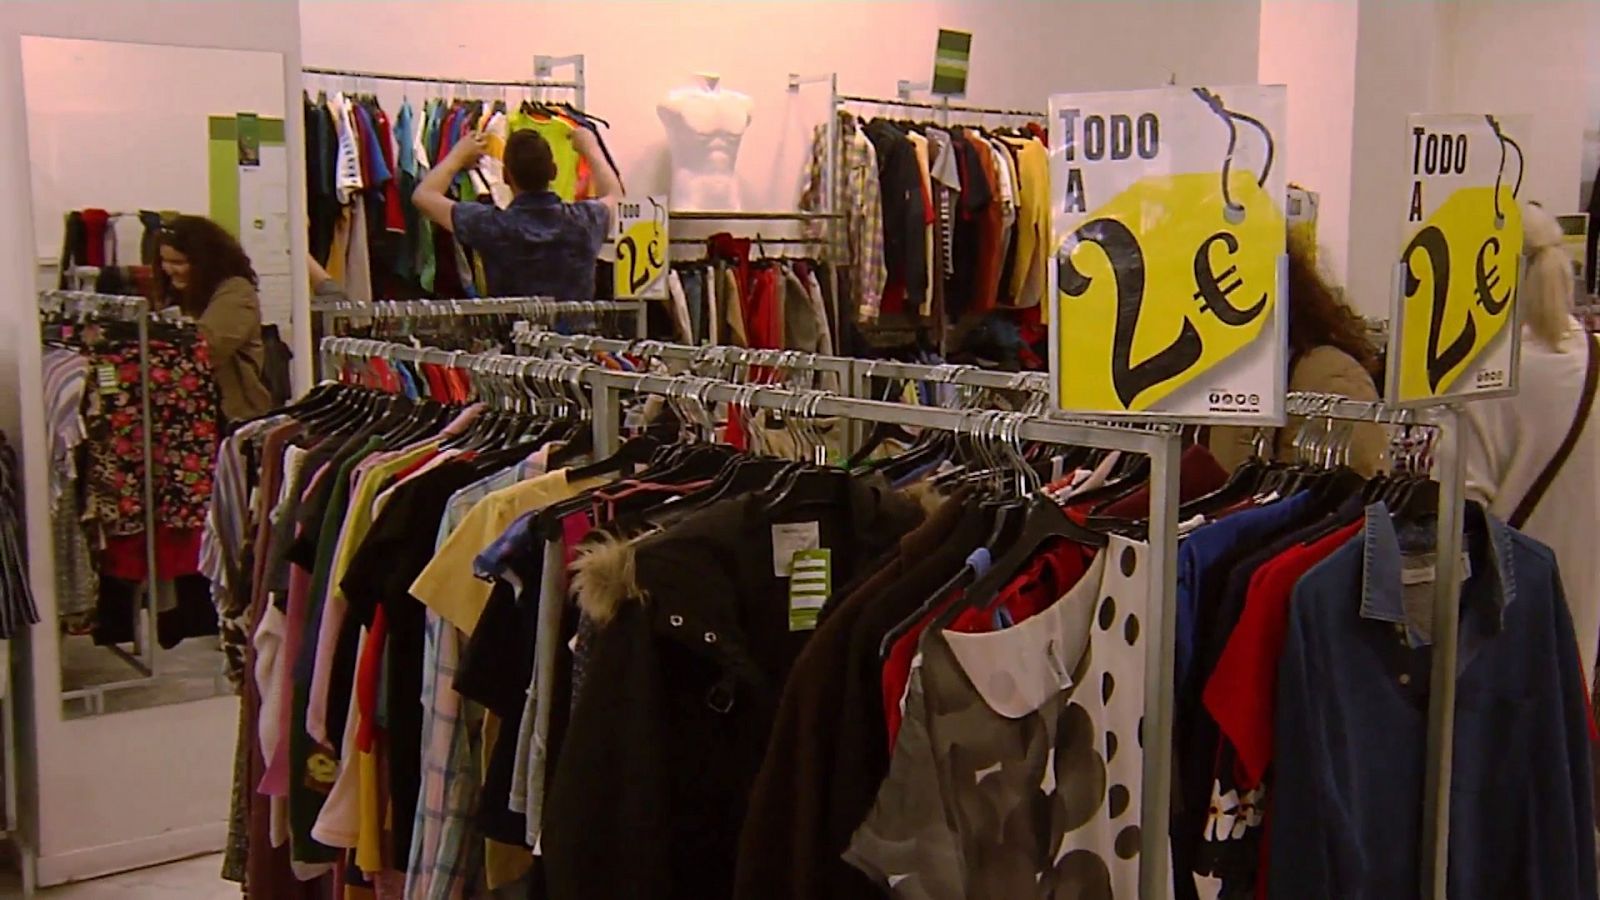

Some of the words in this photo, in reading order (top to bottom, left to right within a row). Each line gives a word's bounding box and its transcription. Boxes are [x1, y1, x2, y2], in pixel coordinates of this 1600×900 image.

[1059, 109, 1160, 161] TODO
[1413, 127, 1467, 175] TODO
[1064, 168, 1087, 213] A
[1409, 181, 1422, 222] A
